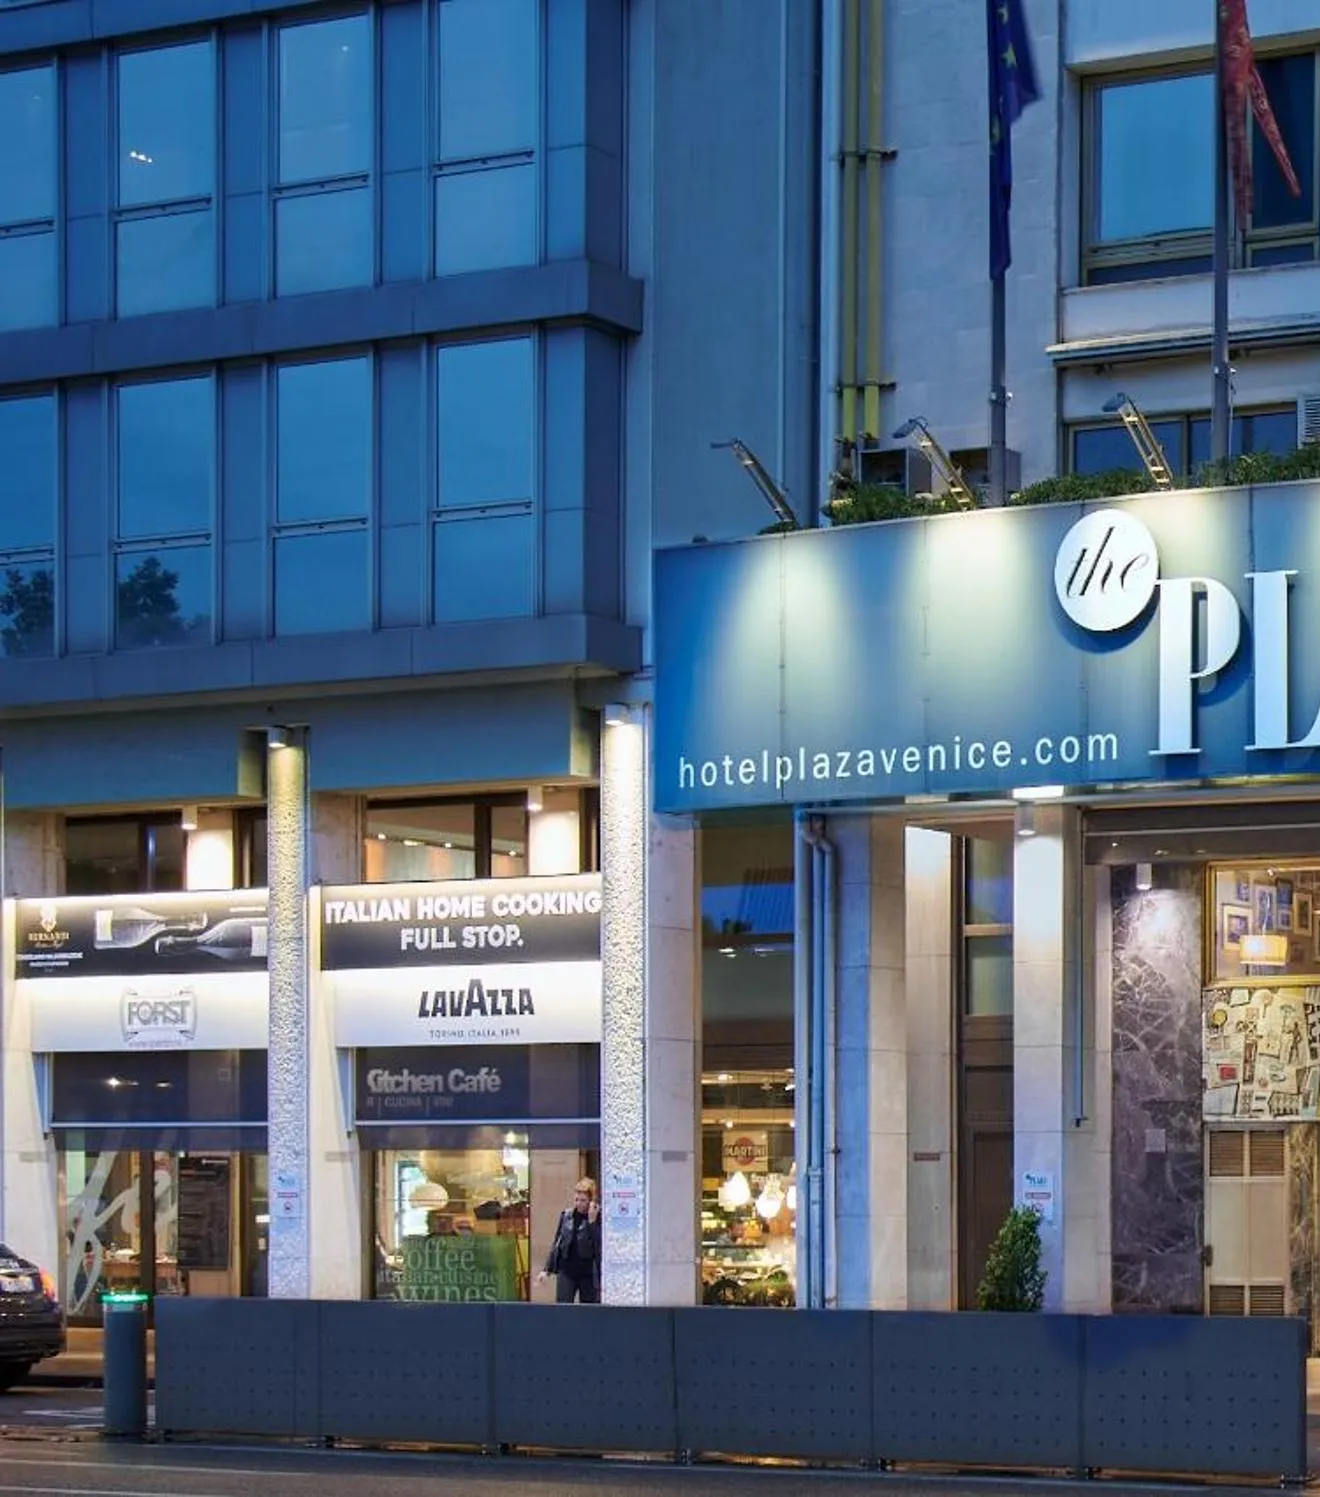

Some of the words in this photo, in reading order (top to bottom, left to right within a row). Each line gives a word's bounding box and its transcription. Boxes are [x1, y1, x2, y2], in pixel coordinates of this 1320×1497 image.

[1065, 525, 1150, 598] the
[678, 732, 1119, 789] hotelplazavenice.com
[324, 899, 407, 924] ITALIAN
[416, 894, 486, 920] HOME
[492, 890, 602, 916] COOKING
[400, 927, 457, 951] FULL
[462, 924, 524, 949] STOP.
[127, 1000, 192, 1026] FORST
[418, 978, 536, 1019] LAVAZZA
[405, 1237, 477, 1270] offee
